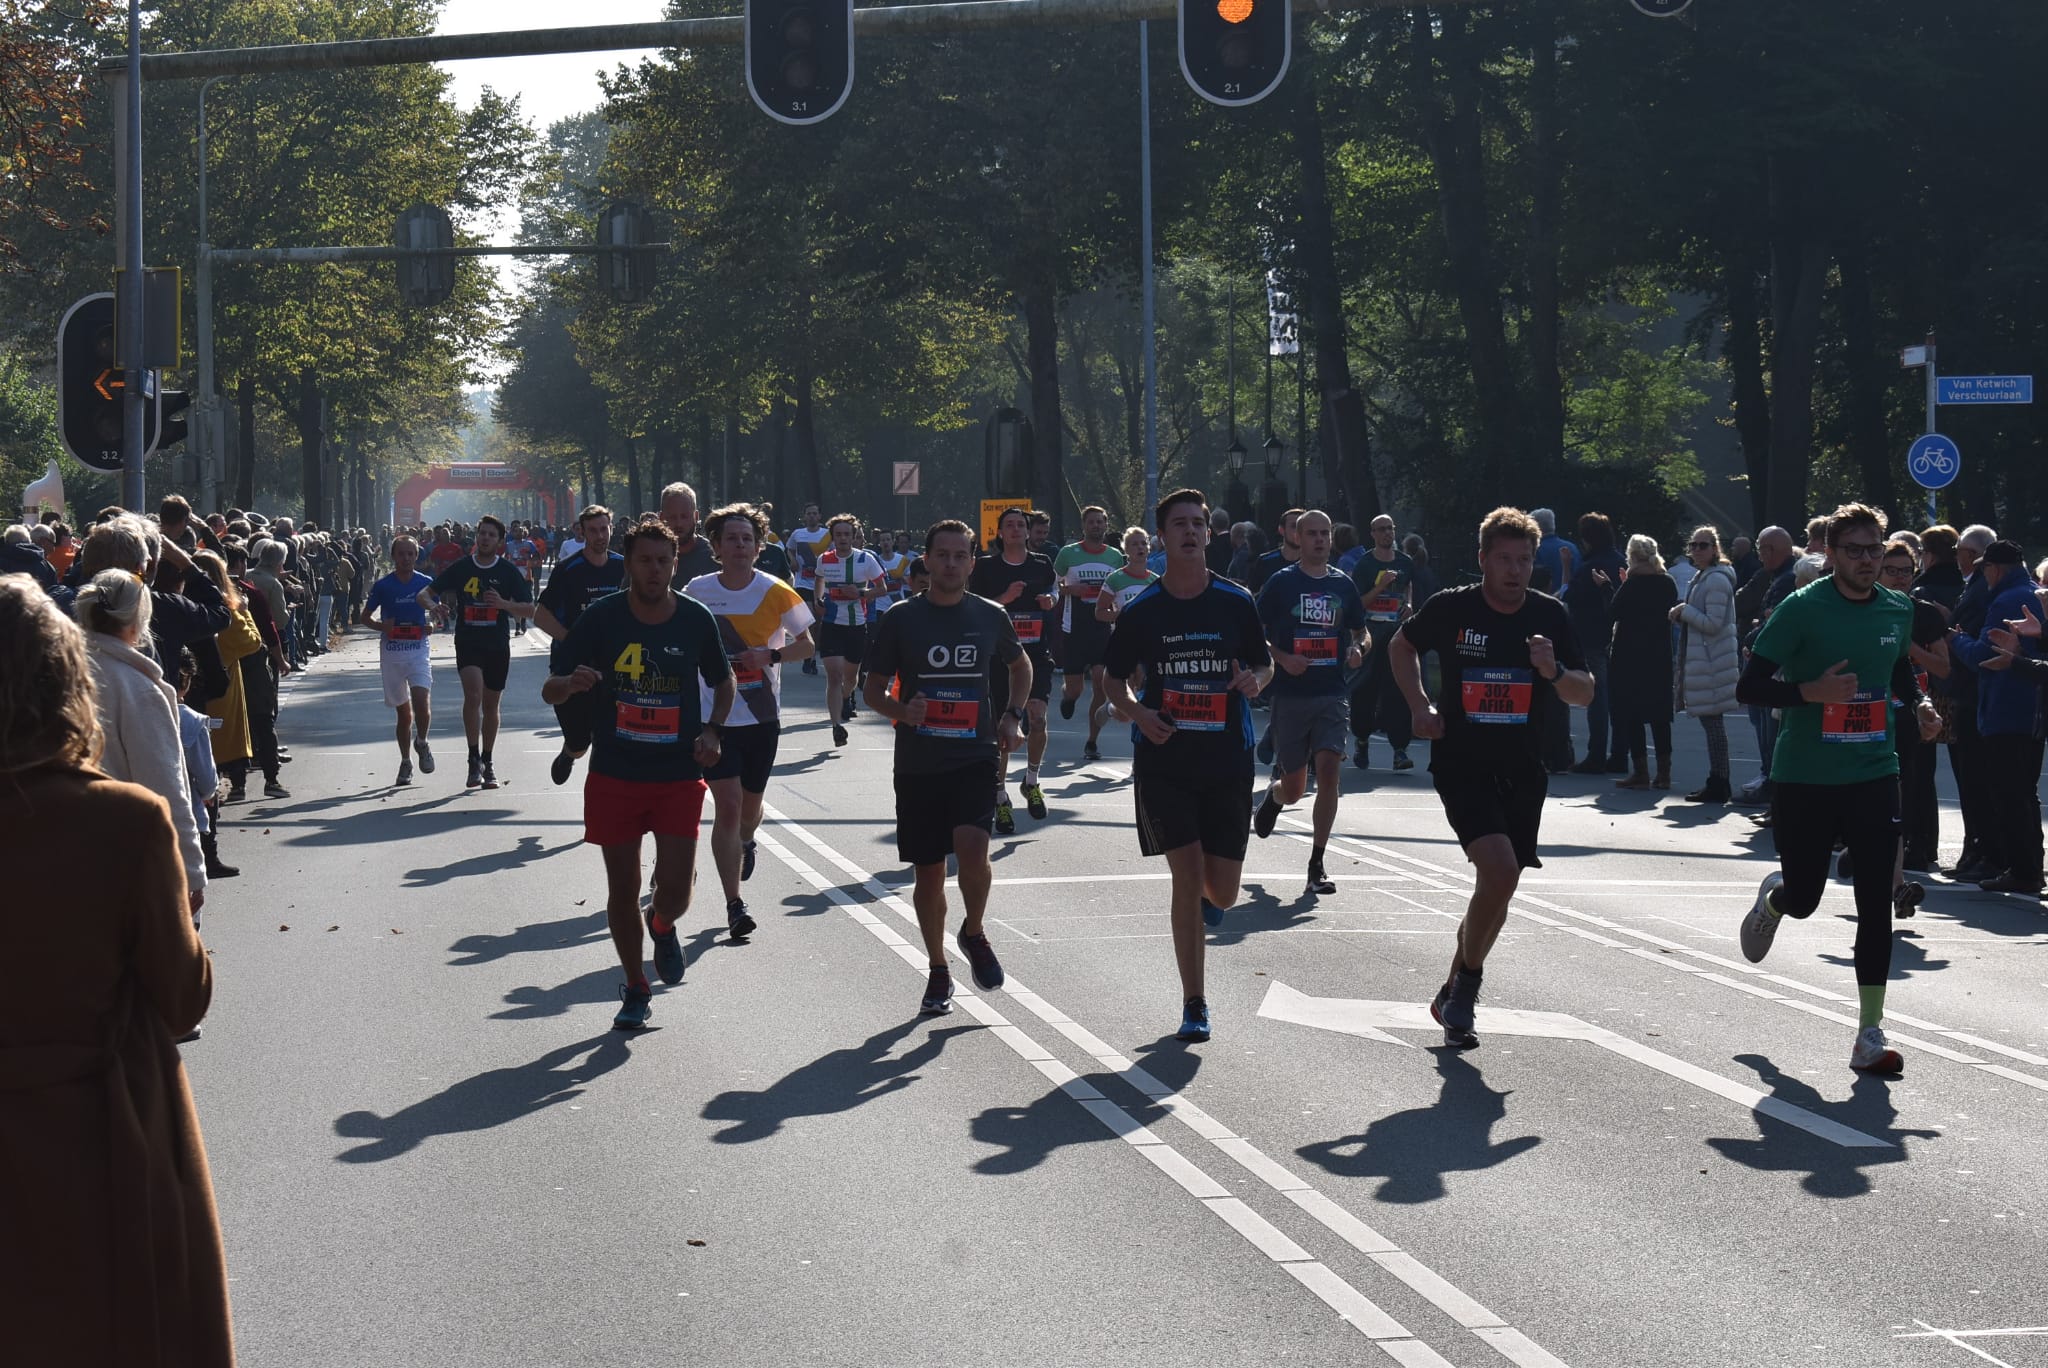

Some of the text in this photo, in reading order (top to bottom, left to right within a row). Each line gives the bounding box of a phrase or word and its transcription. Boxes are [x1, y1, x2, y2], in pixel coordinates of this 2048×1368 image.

[1224, 83, 1240, 93] 2.1
[792, 101, 807, 111] 3.1
[1953, 379, 2017, 389] Van Ketwich
[1948, 391, 2022, 401] Verschuurlaan
[102, 450, 118, 460] 3.2
[463, 576, 480, 600] 4
[1305, 599, 1327, 610] BOI
[1305, 609, 1331, 621] KON
[1162, 635, 1183, 643] Team
[1456, 628, 1488, 645] Afier
[1880, 636, 1897, 646] pwc
[1169, 648, 1215, 660] powered by
[614, 643, 645, 681] 4
[1157, 659, 1228, 675] SAMSUNG
[1484, 672, 1512, 680] menzis
[1183, 683, 1209, 691] menzis
[1484, 684, 1510, 698] 302
[937, 690, 962, 699] menzis
[637, 697, 662, 705] menzis
[1479, 699, 1513, 713] AFIER
[941, 701, 955, 714] 57
[1846, 702, 1871, 718] 295
[641, 707, 656, 720] 61
[1843, 718, 1872, 733] PWC
